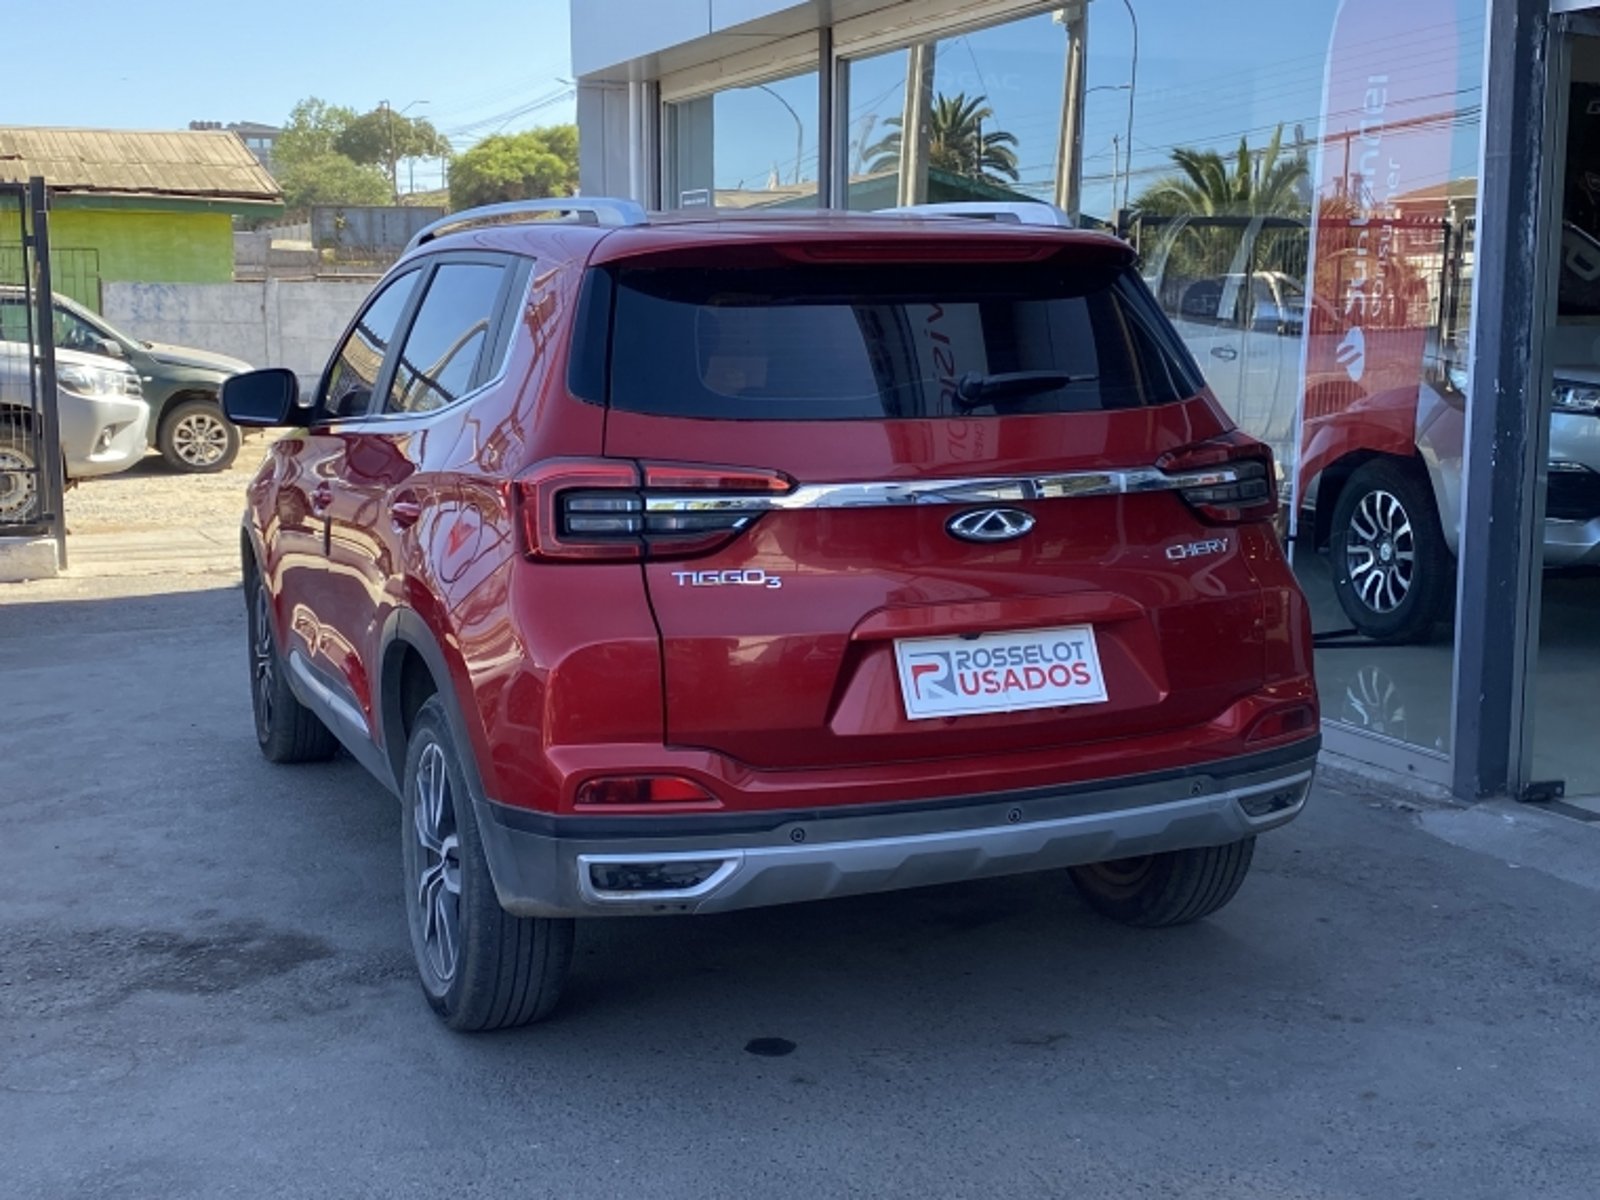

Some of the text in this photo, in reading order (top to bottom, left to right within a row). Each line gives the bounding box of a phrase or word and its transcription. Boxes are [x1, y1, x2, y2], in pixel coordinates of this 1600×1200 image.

[1165, 538, 1228, 559] CHERY
[955, 641, 1084, 670] ROSSELOT
[959, 662, 1091, 696] USADOS
